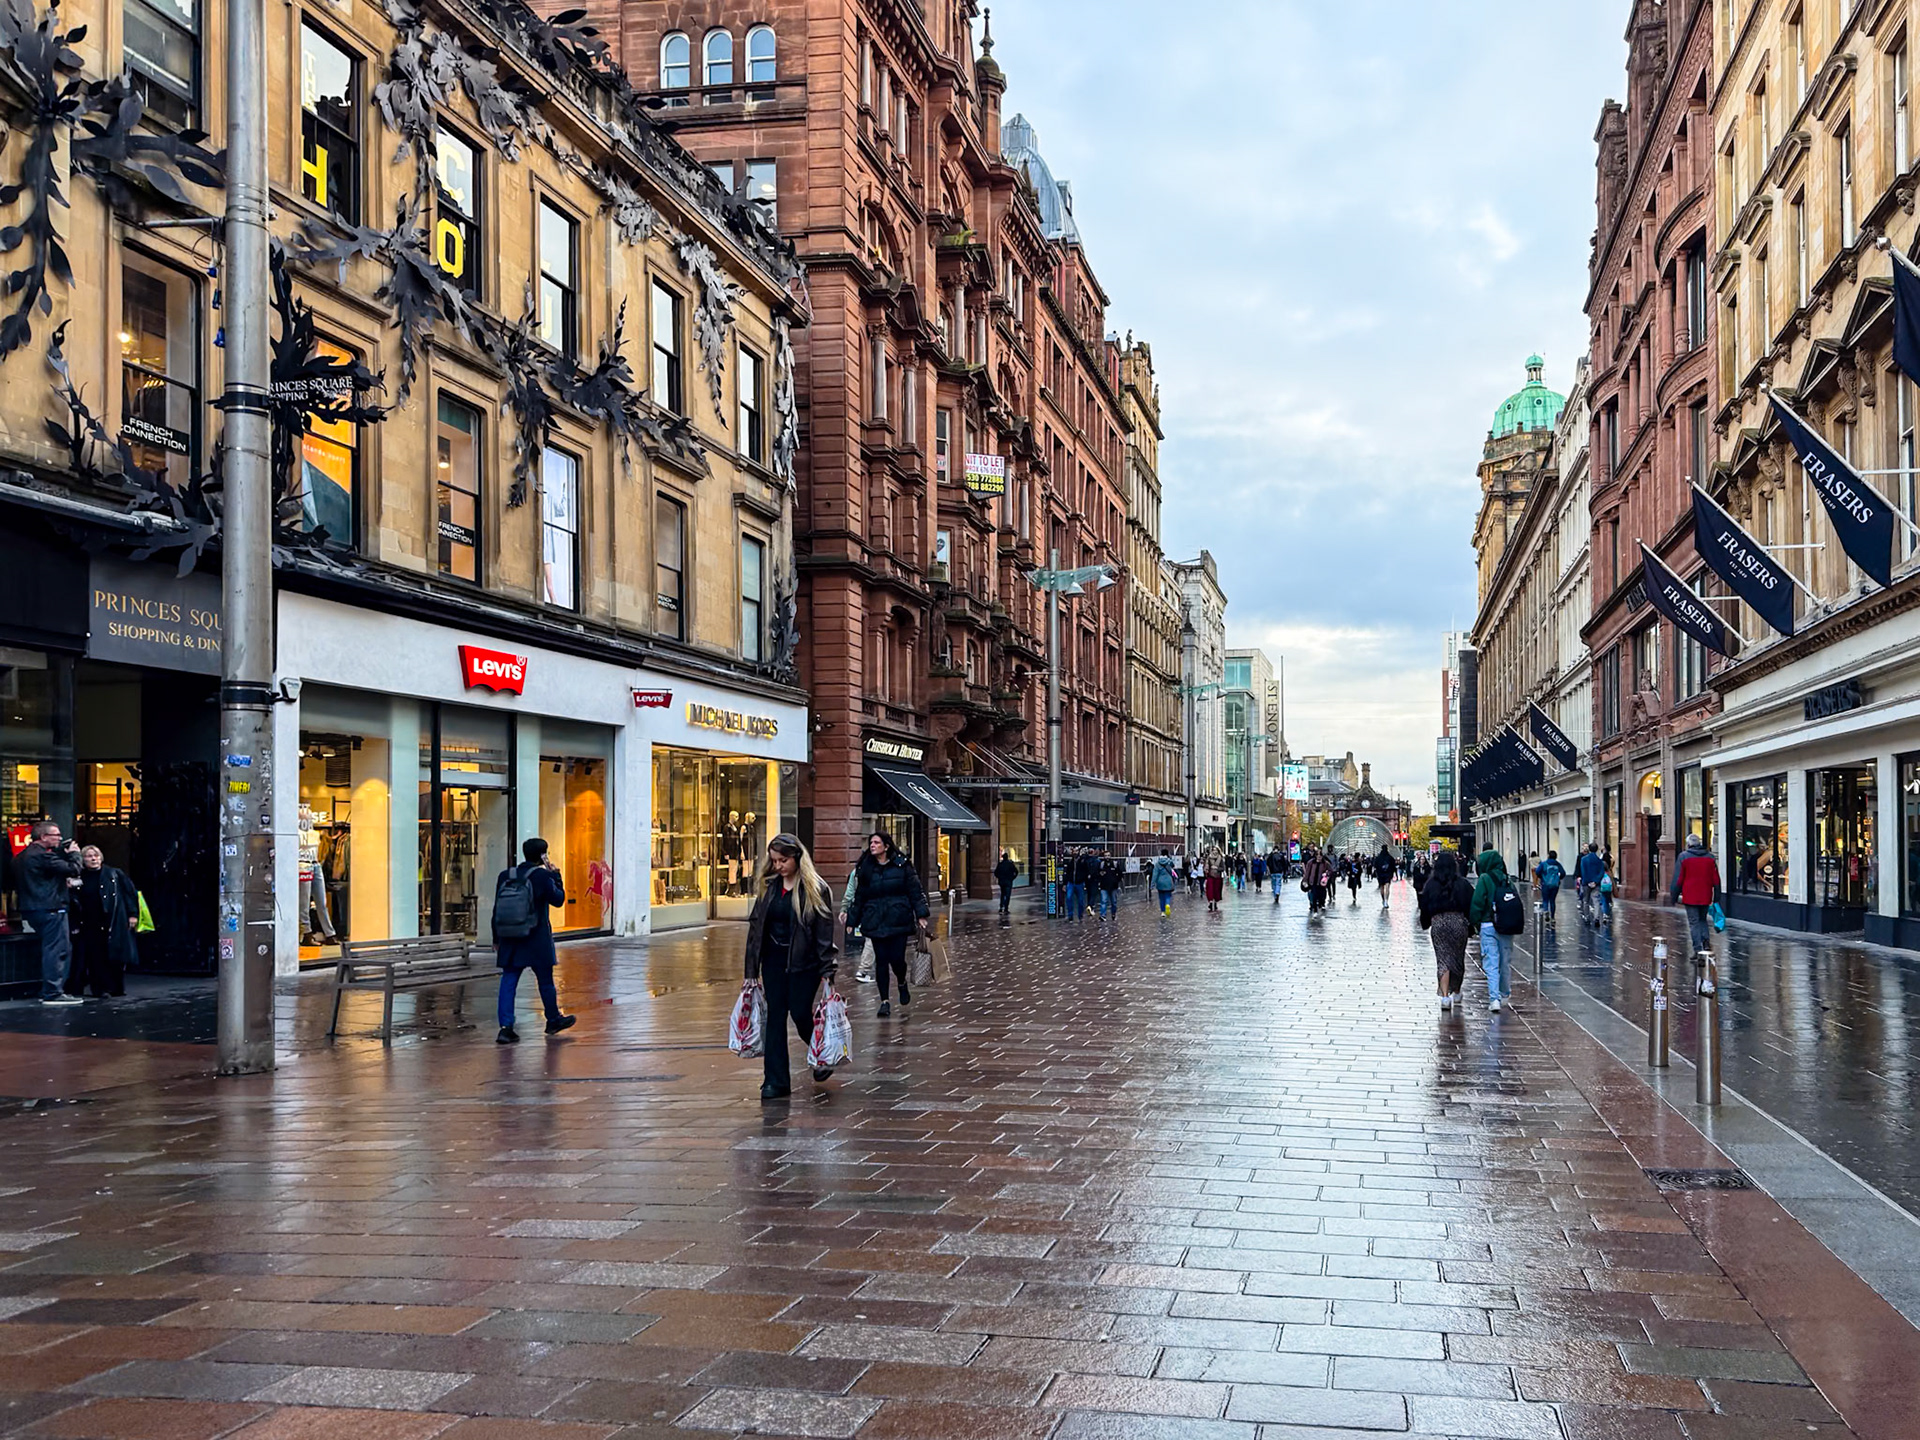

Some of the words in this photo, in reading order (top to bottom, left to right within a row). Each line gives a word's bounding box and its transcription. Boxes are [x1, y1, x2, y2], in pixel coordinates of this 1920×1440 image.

[309, 375, 355, 392] SQUARE
[120, 423, 187, 452] ONNECTION
[129, 417, 174, 439] FRENCH
[979, 456, 989, 466] TO
[990, 457, 1004, 468] LET
[1801, 451, 1874, 523] FRASERS
[438, 521, 465, 535] FRENCH
[1717, 531, 1778, 590] FRASERS
[94, 590, 181, 623] PRINCES
[1663, 584, 1714, 634] FRASERS
[108, 621, 181, 646] SHOPPING
[183, 634, 195, 648] &
[686, 702, 745, 731] MICHAEL
[745, 715, 778, 737] KORS
[1541, 722, 1571, 752] FRASERS
[1514, 740, 1540, 766] FRASERS
[1048, 882, 1056, 915] BUSKING
